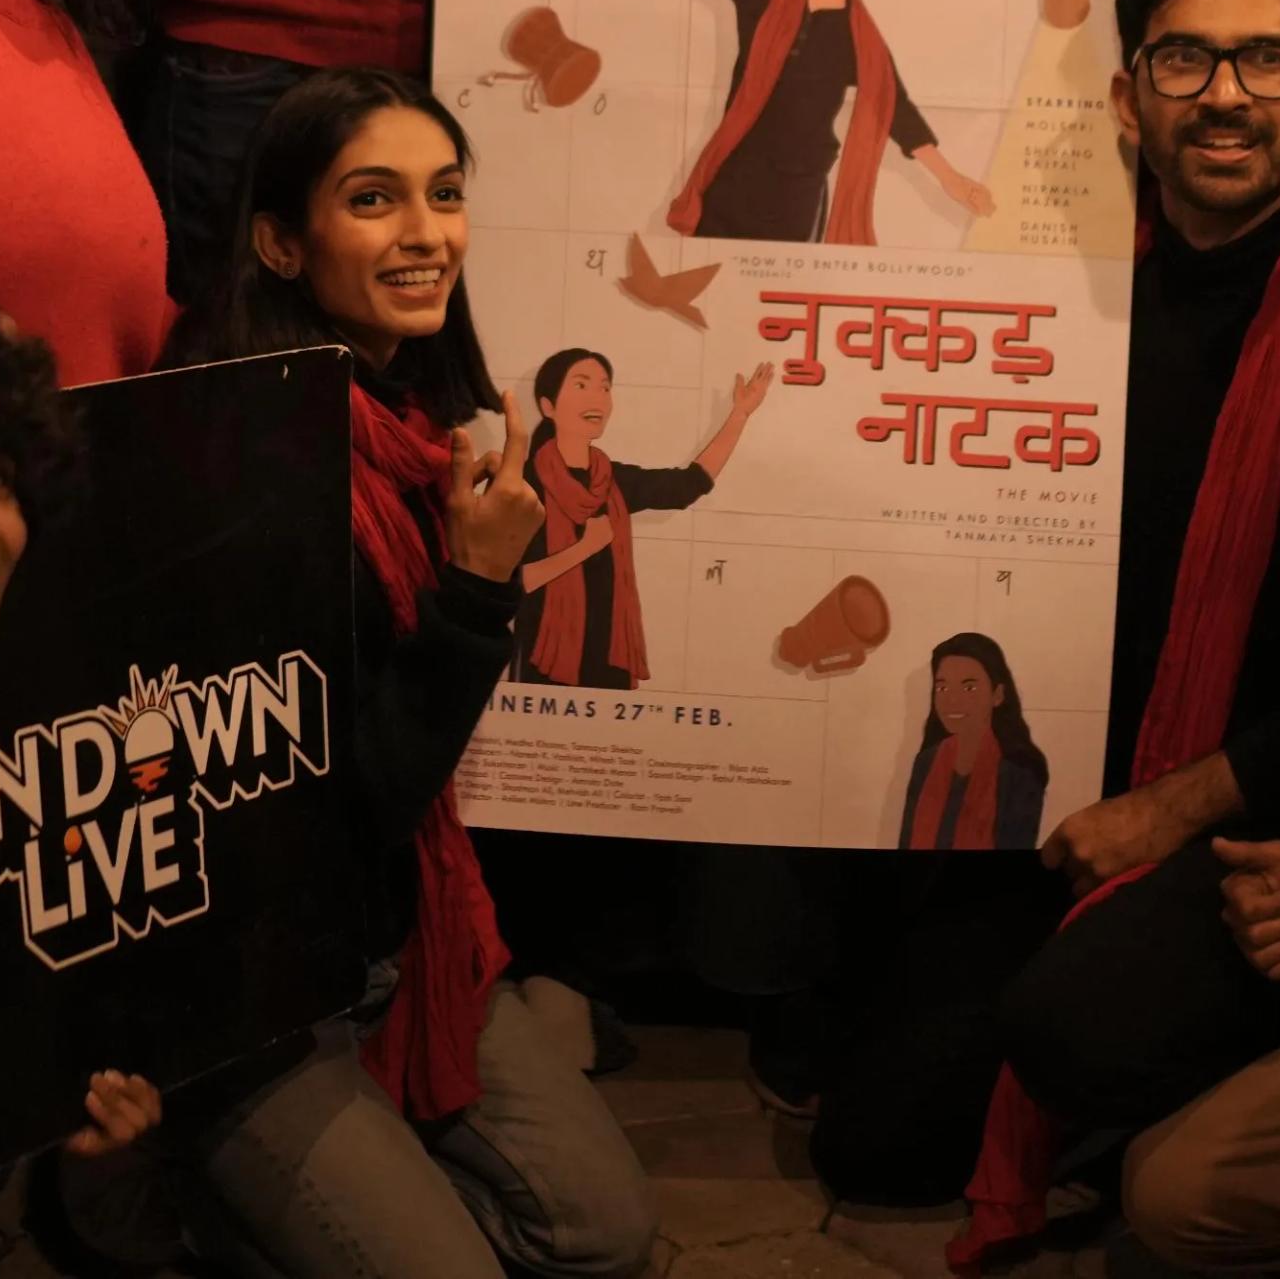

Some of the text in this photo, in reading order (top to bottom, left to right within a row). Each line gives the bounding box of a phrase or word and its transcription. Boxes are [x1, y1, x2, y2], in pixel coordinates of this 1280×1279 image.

[1026, 97, 1106, 110] STARRING
[786, 258, 806, 270] TO
[758, 291, 1057, 387] नुक्कड़
[856, 393, 1101, 473] नाटक
[996, 487, 1099, 505] THE MOVIE
[880, 508, 1097, 530] WRITTEN AND DIRECTED BY
[945, 529, 1097, 548] TANMAYA SHEKHAR
[486, 694, 597, 719] INEMAS
[674, 706, 734, 728] FEB.
